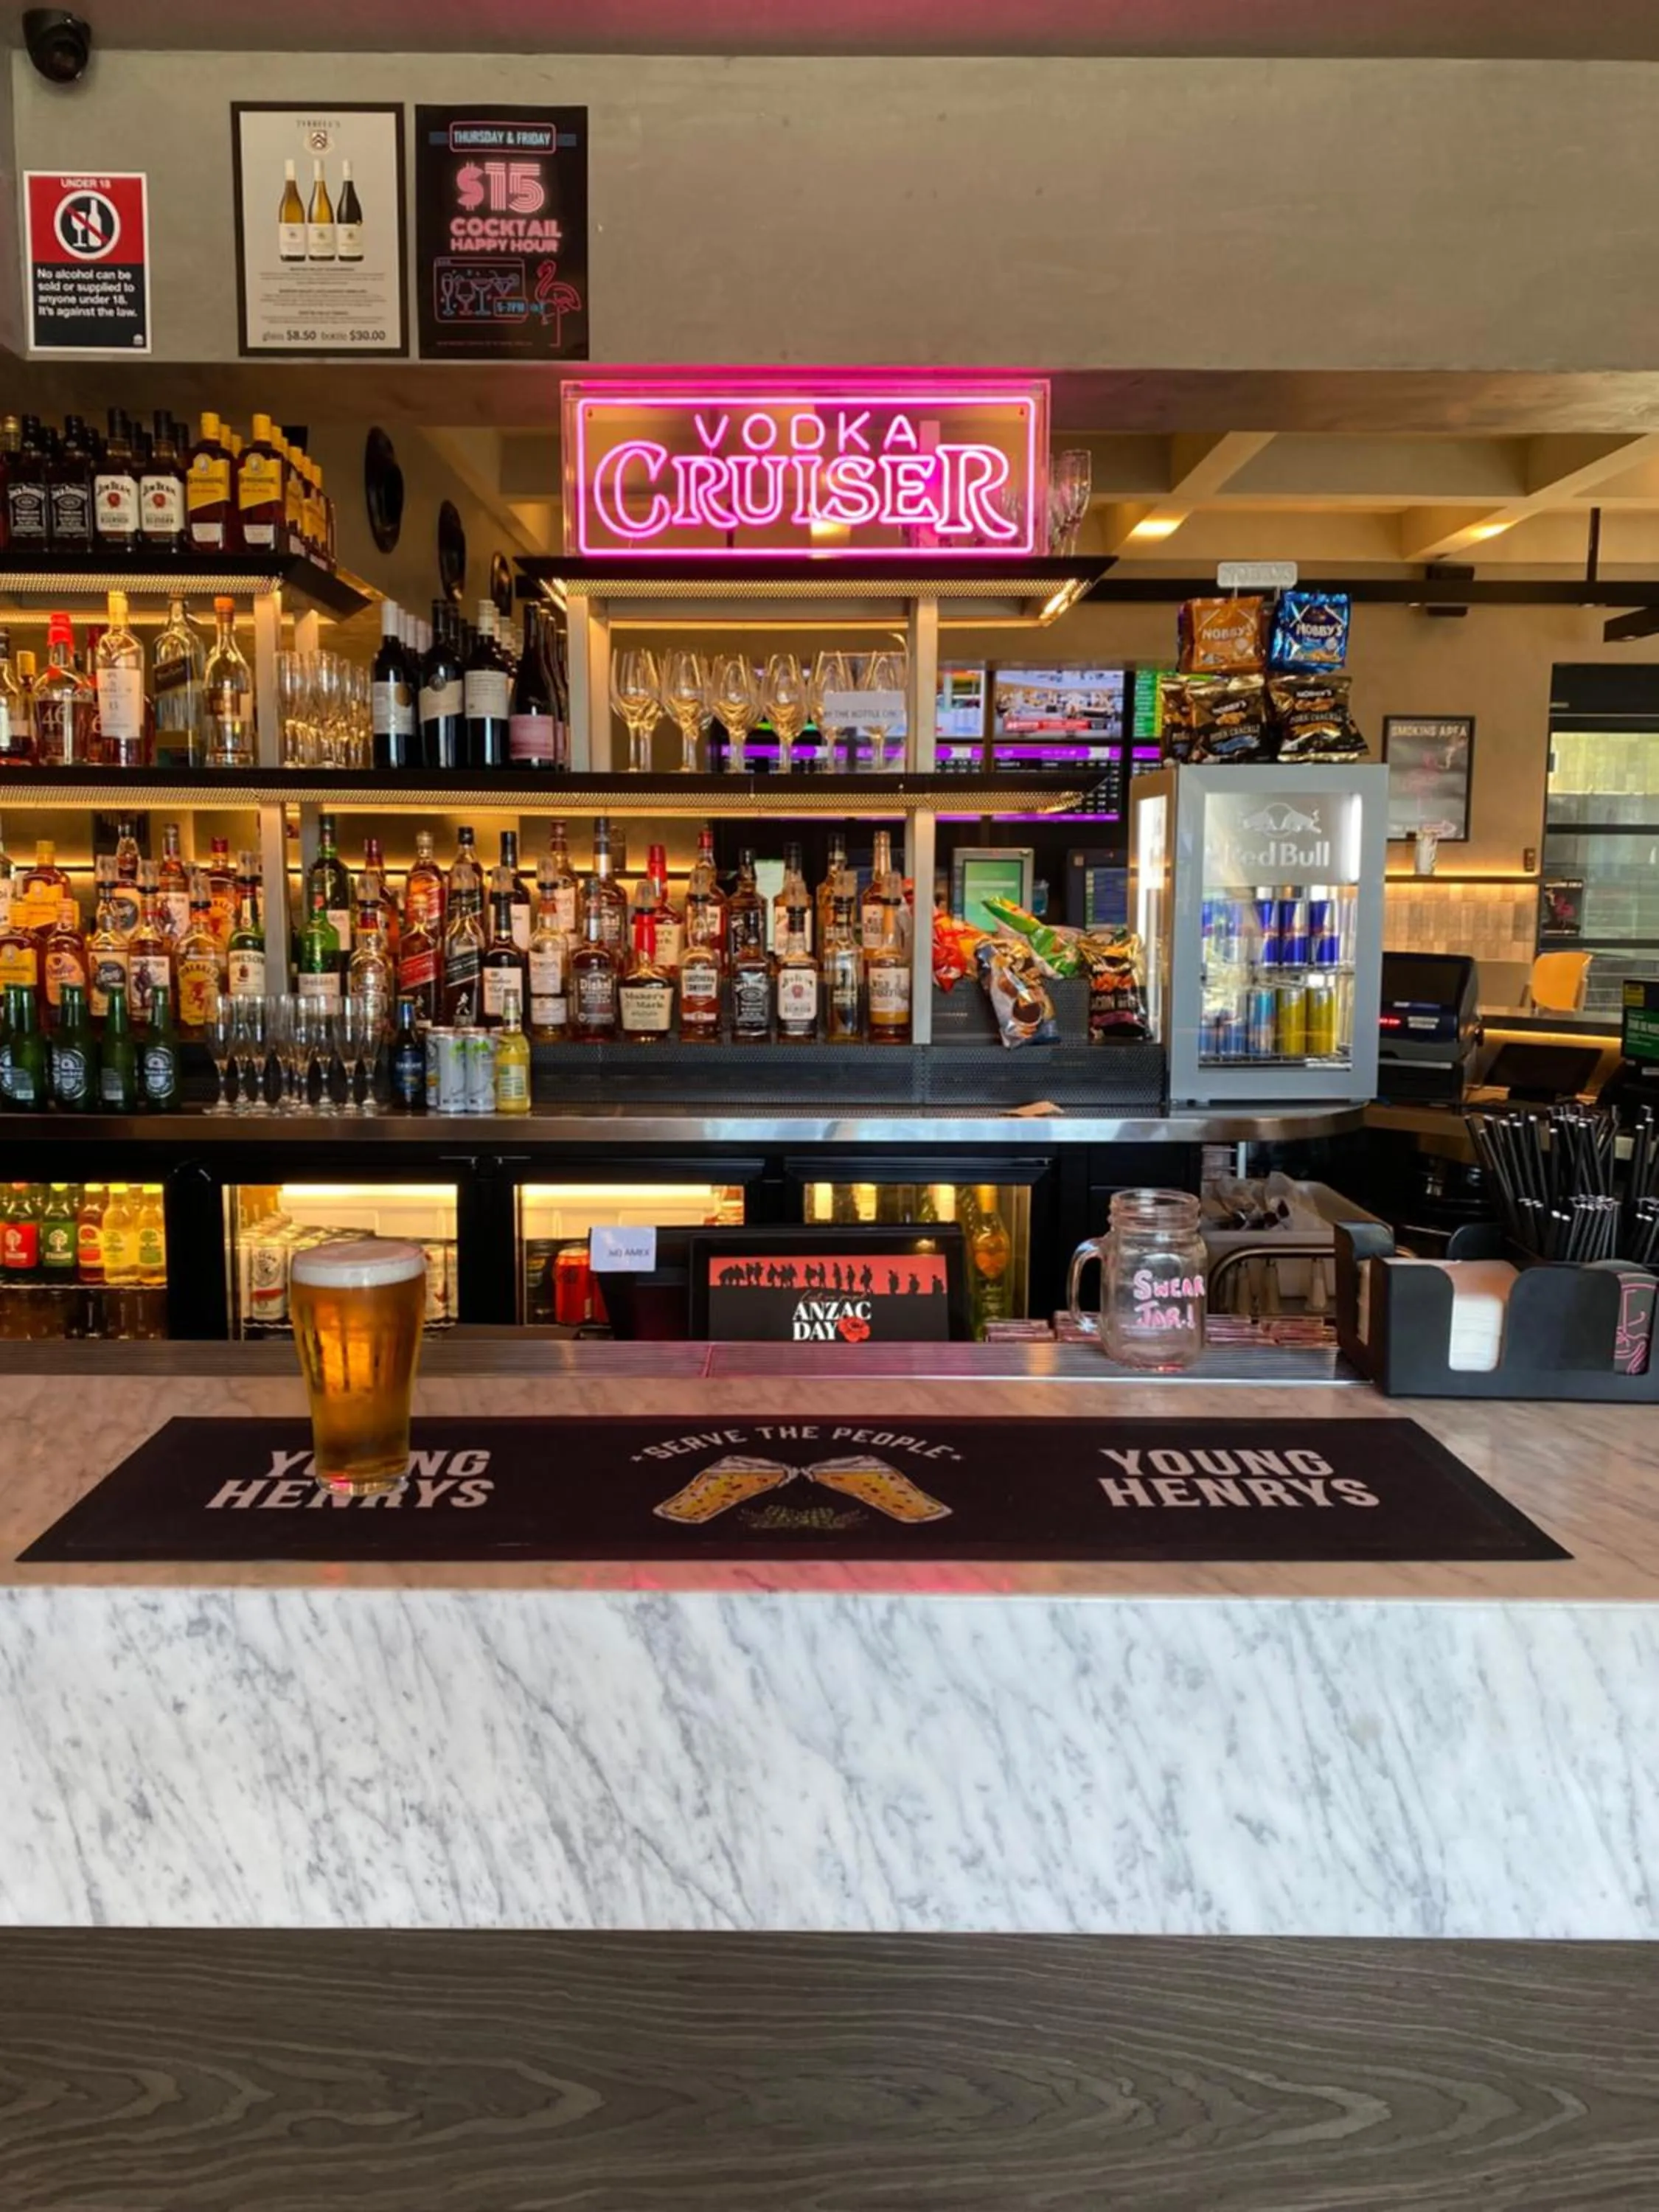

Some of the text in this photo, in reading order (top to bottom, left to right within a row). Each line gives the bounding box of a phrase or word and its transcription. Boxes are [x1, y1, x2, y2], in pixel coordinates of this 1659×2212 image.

[453, 131, 551, 146] THURSDAY & FRIDAY
[60, 178, 97, 188] UNDER
[456, 160, 545, 213] $15
[451, 218, 562, 237] COCKTAIL
[451, 238, 558, 253] HAPPY HOUR
[37, 268, 132, 280] No alcohol can be
[38, 282, 135, 295] sold or supplied to
[38, 296, 76, 306] anyone
[79, 295, 110, 305] under
[38, 307, 138, 319] It's against the law.
[349, 330, 386, 341] $30.00
[694, 411, 917, 452] VODKA
[594, 441, 1018, 538] CRUISER
[1202, 625, 1253, 640] NOBBY'S
[1279, 841, 1329, 866] Bull
[793, 1301, 871, 1321] ANZAC
[793, 1321, 838, 1340] DAY
[644, 1427, 955, 1459] SERVE THE PEOPLE
[265, 1450, 491, 1476] YNG
[1099, 1449, 1335, 1475] YOUNG
[1098, 1478, 1380, 1506] HENRYS
